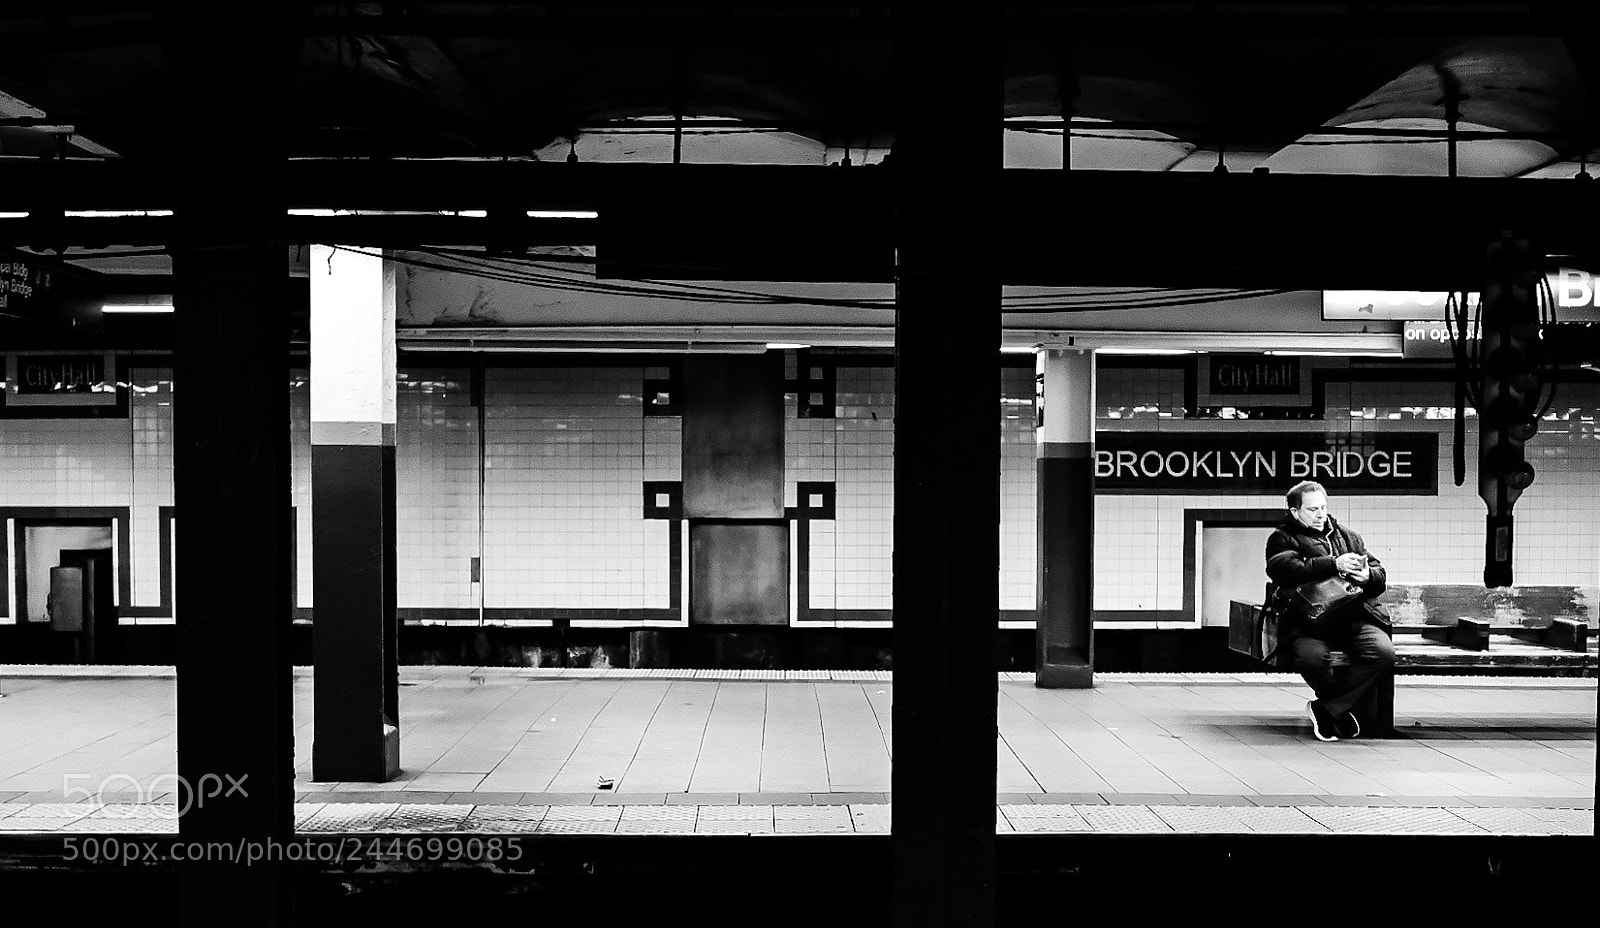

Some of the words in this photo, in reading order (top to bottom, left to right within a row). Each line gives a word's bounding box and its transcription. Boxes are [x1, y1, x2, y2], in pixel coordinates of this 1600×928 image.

[1404, 329, 1426, 341] on
[26, 364, 60, 391] City
[61, 363, 96, 387] Hall
[1218, 364, 1250, 391] City
[1255, 364, 1292, 387] Hall
[1094, 450, 1277, 478] BROOKLYN
[1290, 450, 1413, 478] BRIDGE
